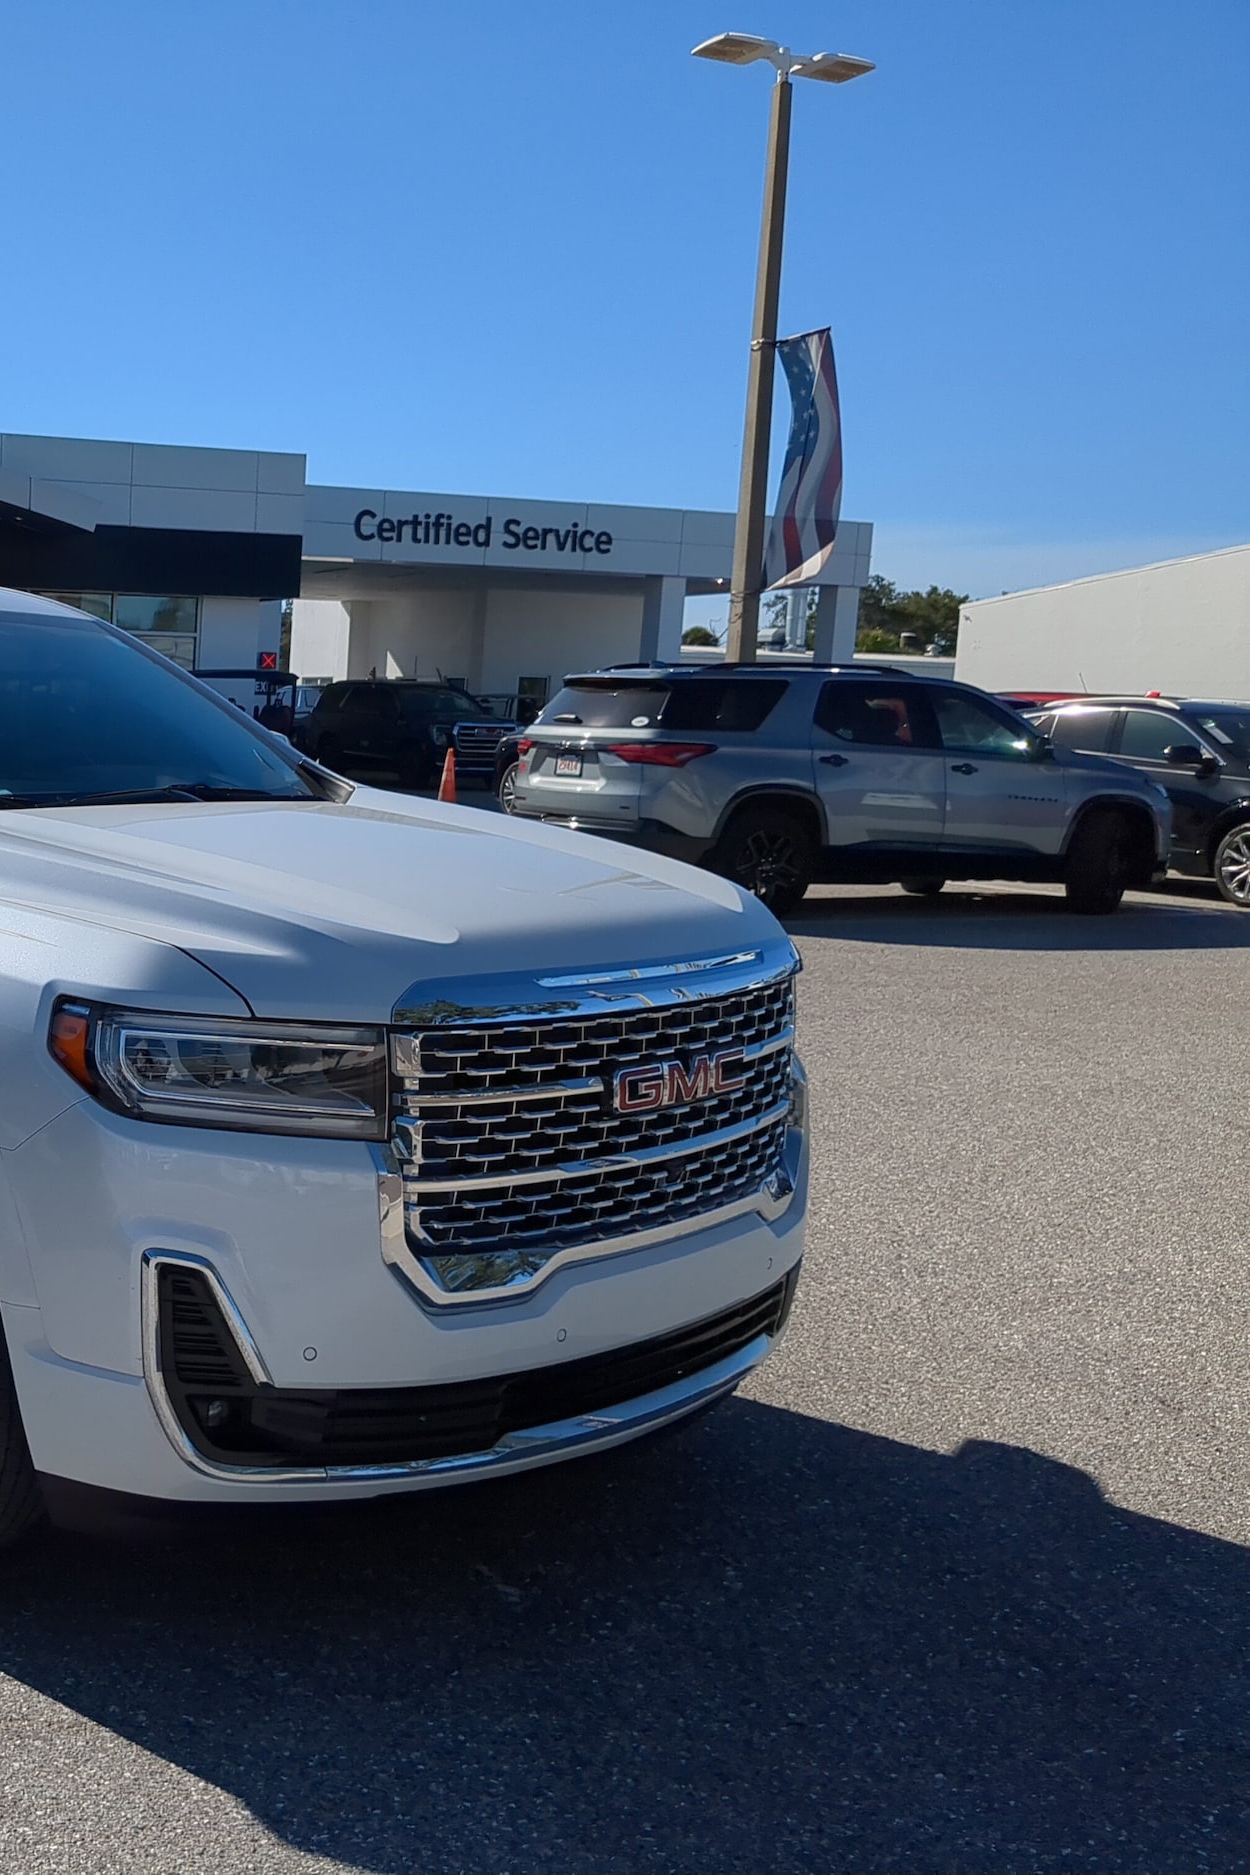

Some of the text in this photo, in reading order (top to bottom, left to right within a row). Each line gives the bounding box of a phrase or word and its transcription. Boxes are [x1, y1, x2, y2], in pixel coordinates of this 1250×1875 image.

[354, 509, 613, 555] Certified Service
[613, 1047, 746, 1113] GMC
